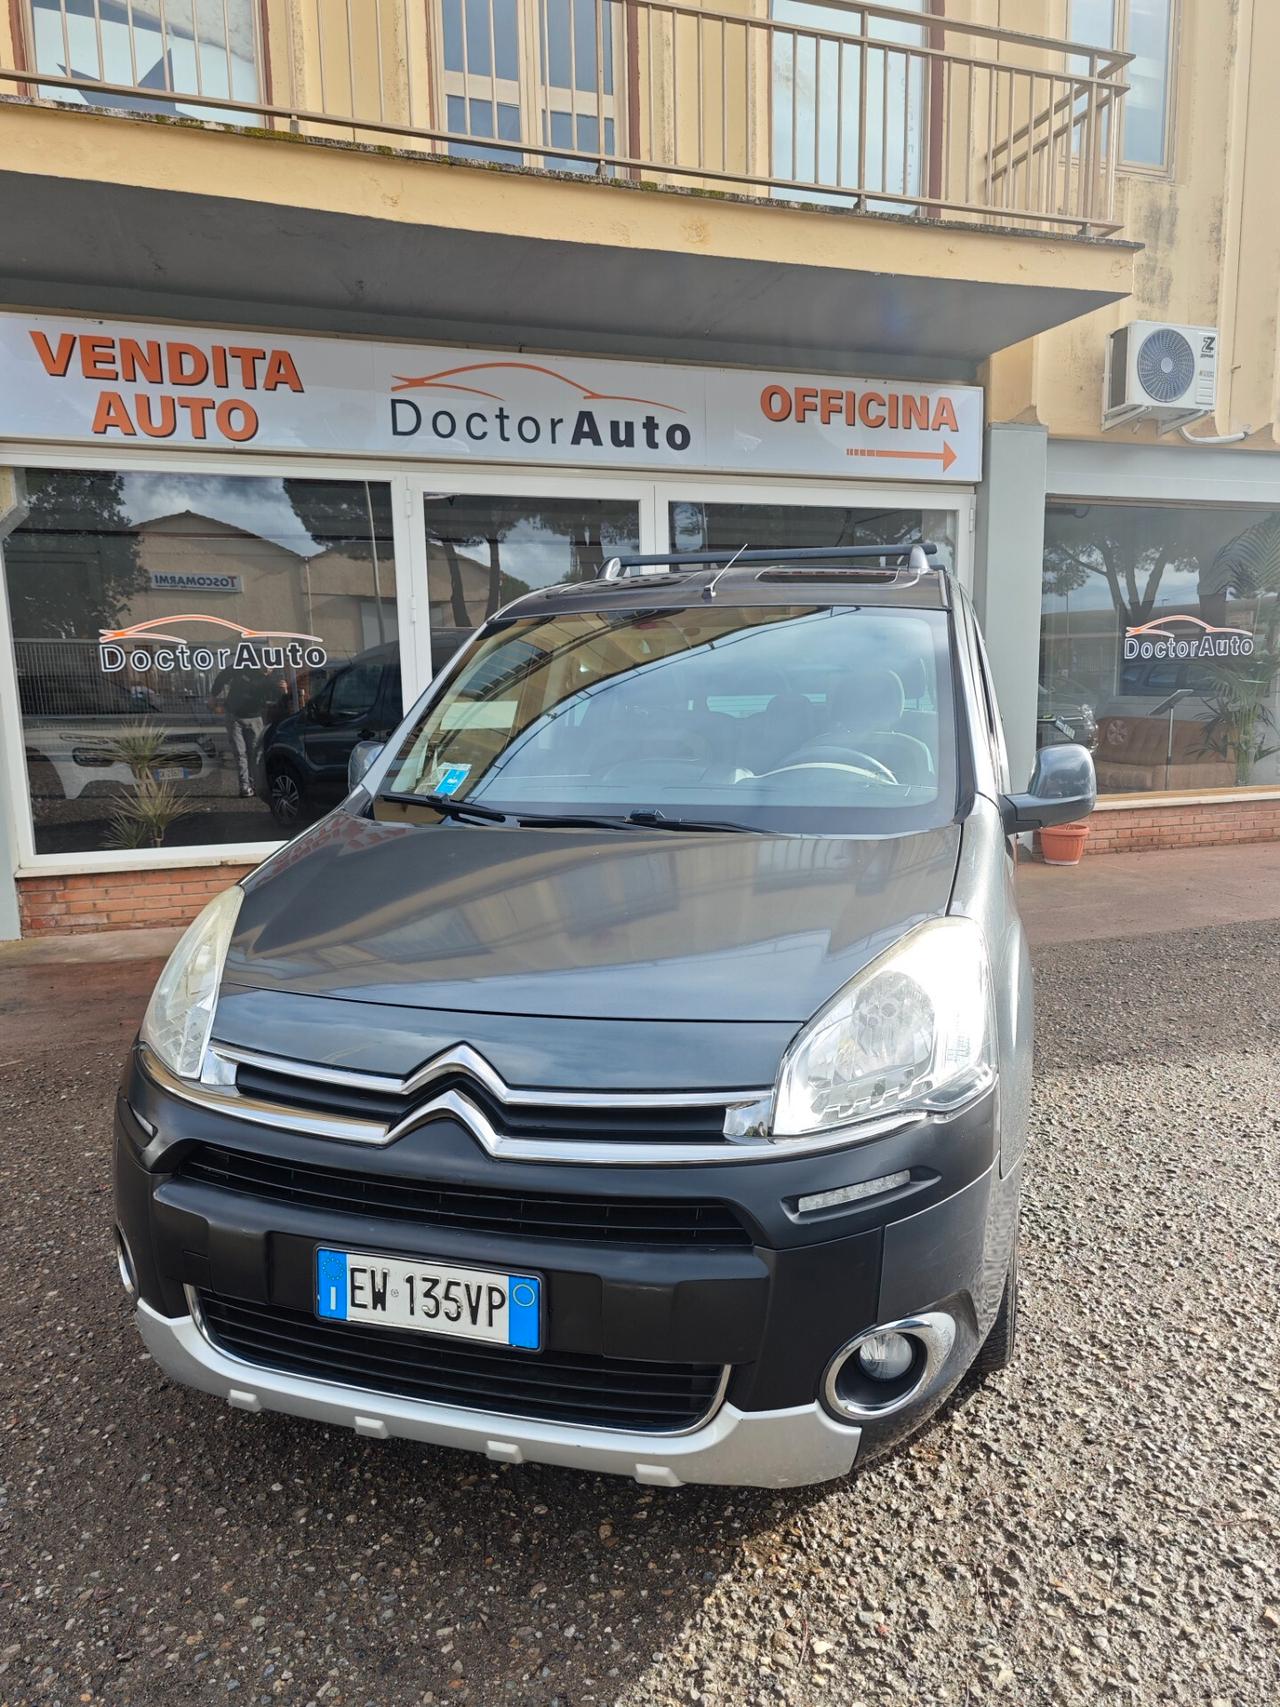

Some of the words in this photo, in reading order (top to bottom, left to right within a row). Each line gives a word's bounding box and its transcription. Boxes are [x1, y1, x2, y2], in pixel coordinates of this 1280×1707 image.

[29, 330, 304, 393] VENDITA
[91, 391, 259, 442] AUTO
[760, 384, 959, 432] OFFICINA
[99, 642, 327, 672] DoctorAuto
[1124, 635, 1254, 659] DoctorAuto
